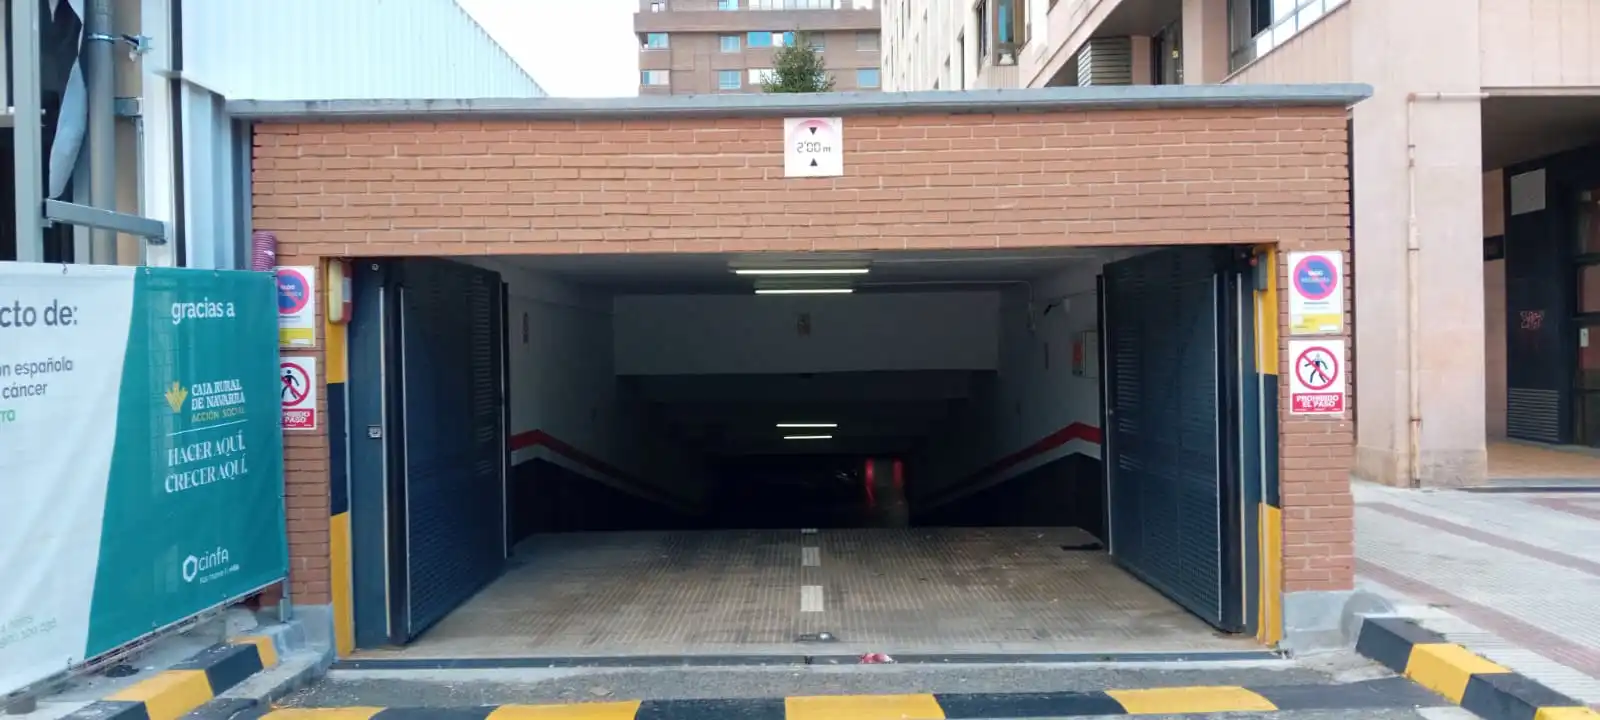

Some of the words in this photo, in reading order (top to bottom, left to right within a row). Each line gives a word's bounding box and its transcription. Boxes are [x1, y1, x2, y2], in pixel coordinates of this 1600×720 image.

[822, 145, 831, 153] m
[43, 298, 78, 327] de:
[171, 296, 224, 325] gracias
[226, 302, 236, 318] a
[14, 356, 74, 379] española
[2, 382, 48, 399] cáncer
[191, 382, 213, 397] CAJA
[213, 379, 243, 394] RURAL
[191, 397, 204, 411] DE
[206, 391, 246, 409] NAVARRA
[1313, 400, 1335, 408] PASO
[191, 410, 220, 423] ACCIÓN
[167, 440, 212, 467] HACER
[213, 429, 246, 457] AQUÍ.
[164, 465, 216, 493] CRECER
[217, 453, 248, 480] AQUÍ.
